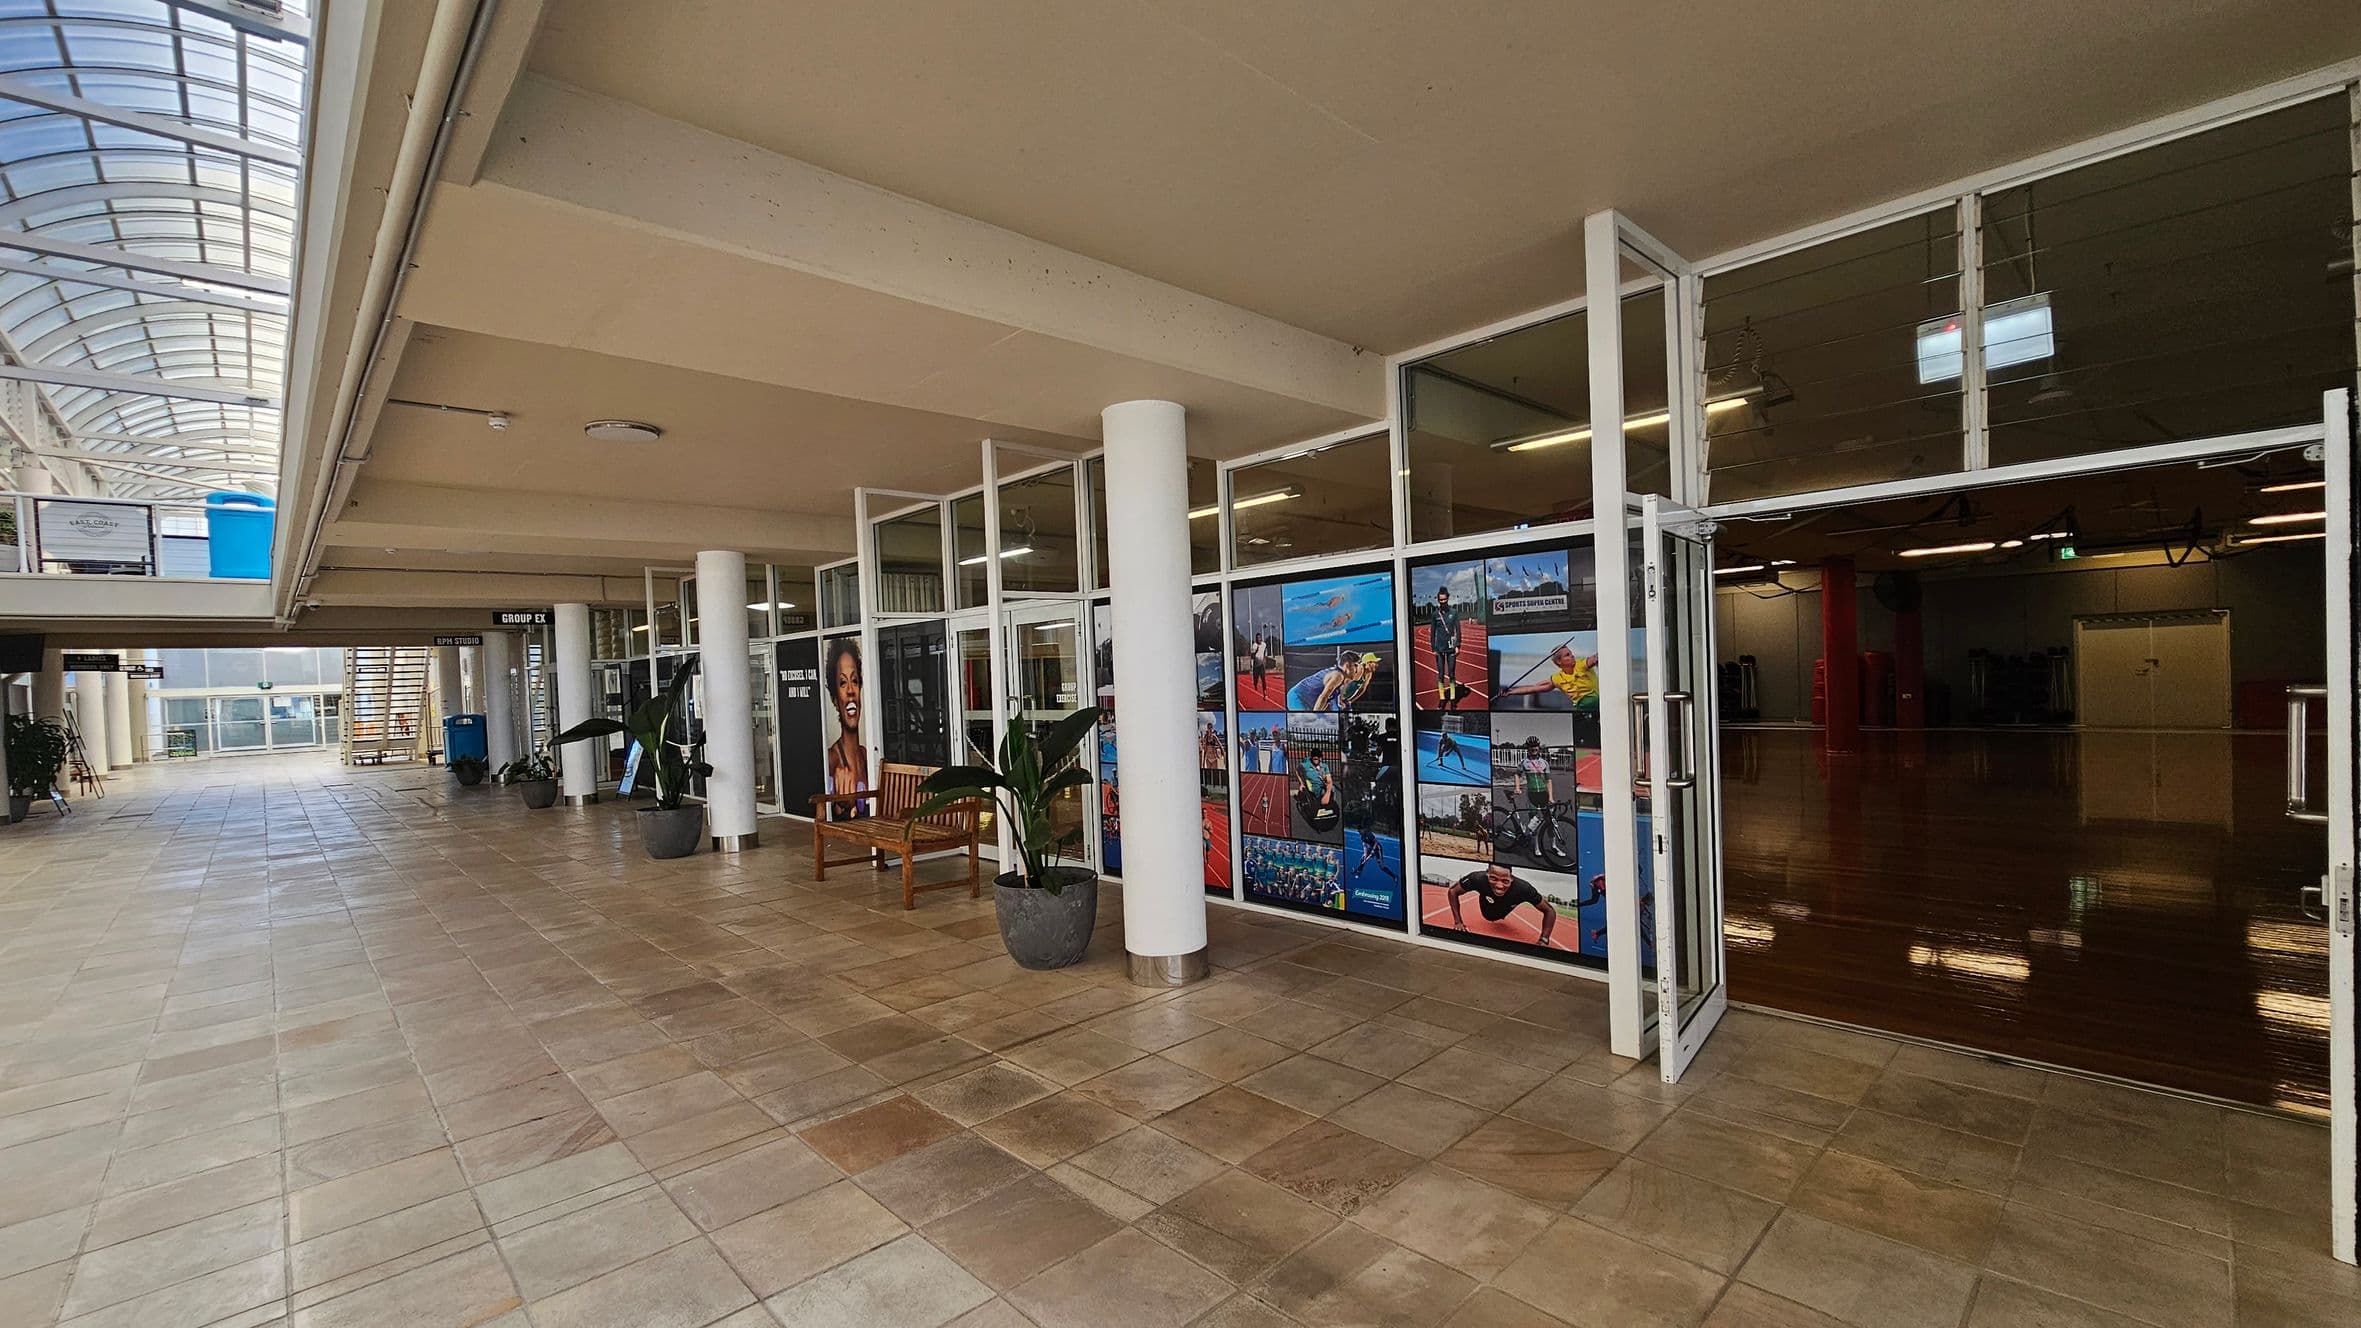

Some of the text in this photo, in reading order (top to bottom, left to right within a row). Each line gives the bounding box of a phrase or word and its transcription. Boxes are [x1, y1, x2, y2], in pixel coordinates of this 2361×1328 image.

[93, 520, 119, 528] COAST
[1505, 600, 1526, 608] SPORTS
[1544, 598, 1564, 606] CENTRE
[502, 613, 546, 624] GROUP EX
[437, 636, 480, 645] RPM STUDIO
[1056, 693, 1077, 703] EXERCISE
